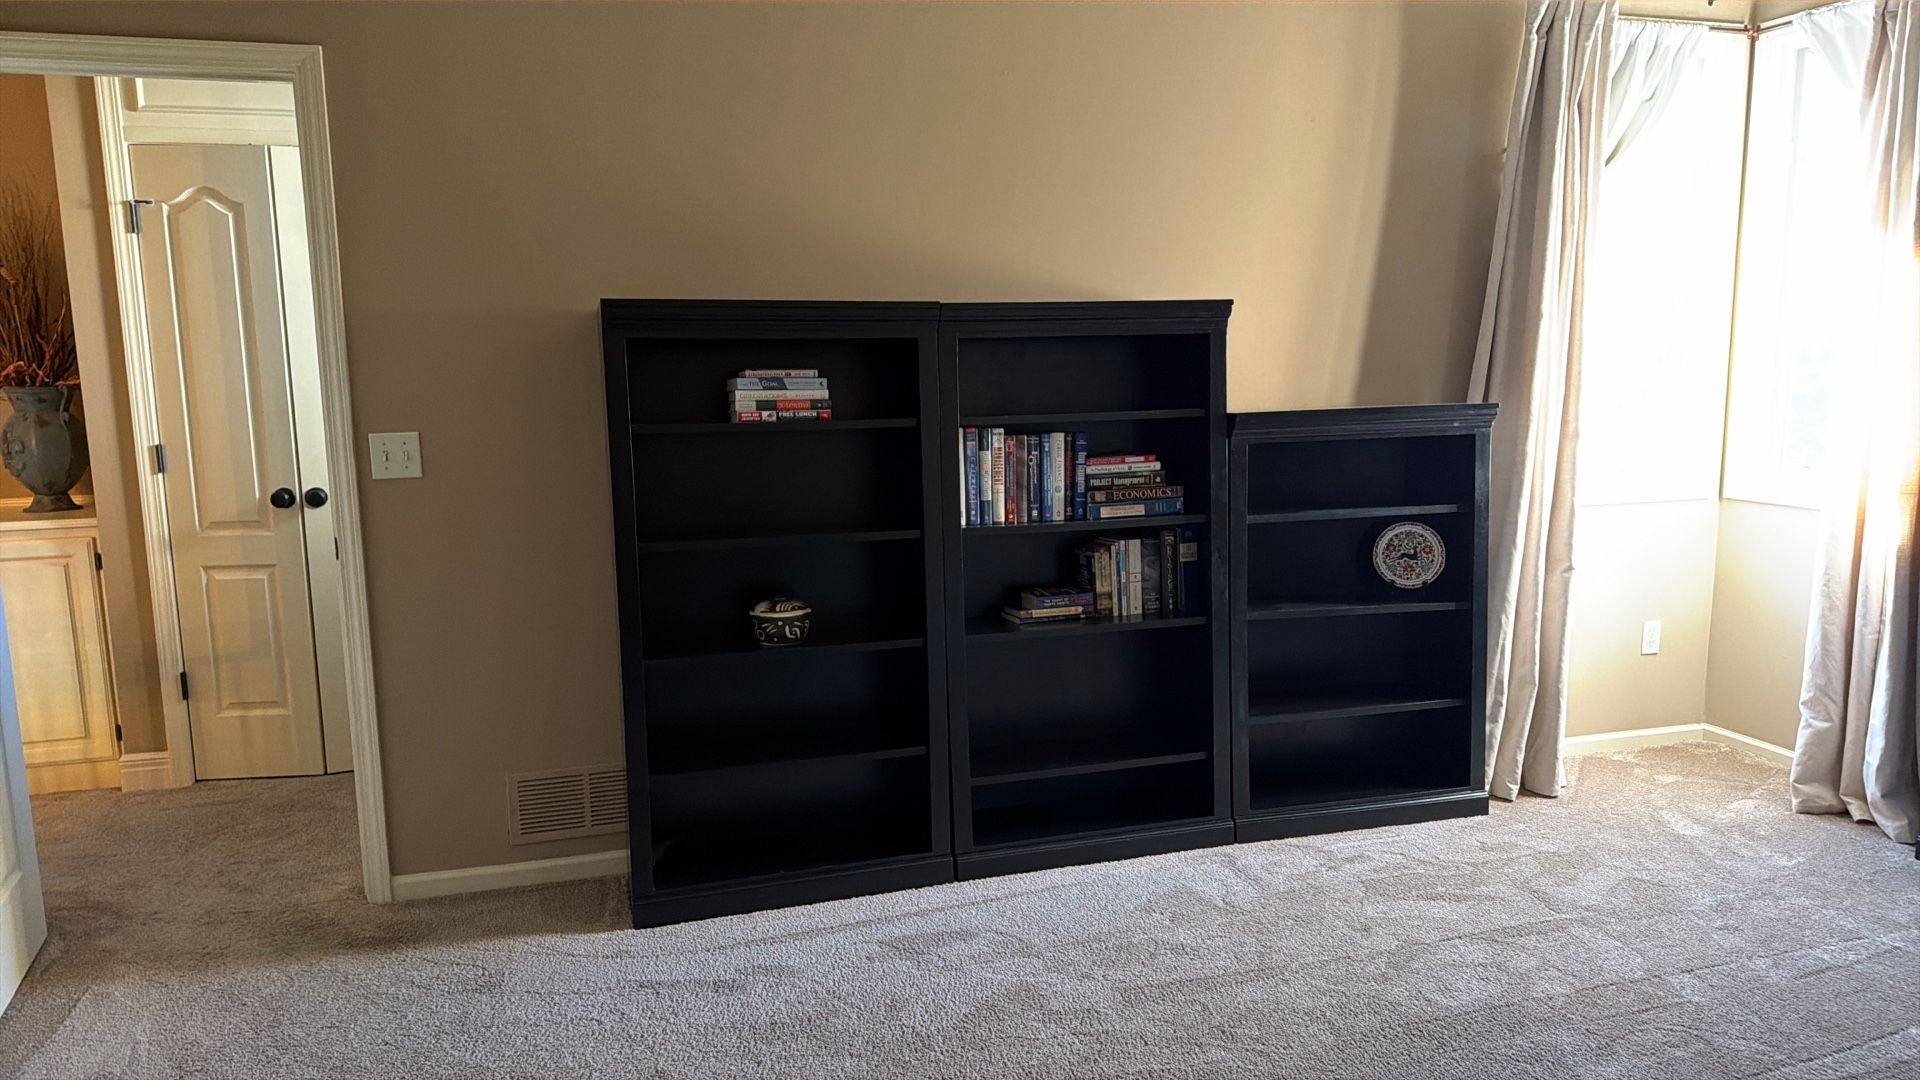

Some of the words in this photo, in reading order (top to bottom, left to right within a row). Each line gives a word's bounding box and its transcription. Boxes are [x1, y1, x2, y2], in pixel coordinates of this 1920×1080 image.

[993, 447, 1004, 486] MANAGEMENT
[1090, 478, 1112, 486] PROJECT
[1113, 476, 1145, 486] Management
[1113, 487, 1172, 500] ECONOMICS
